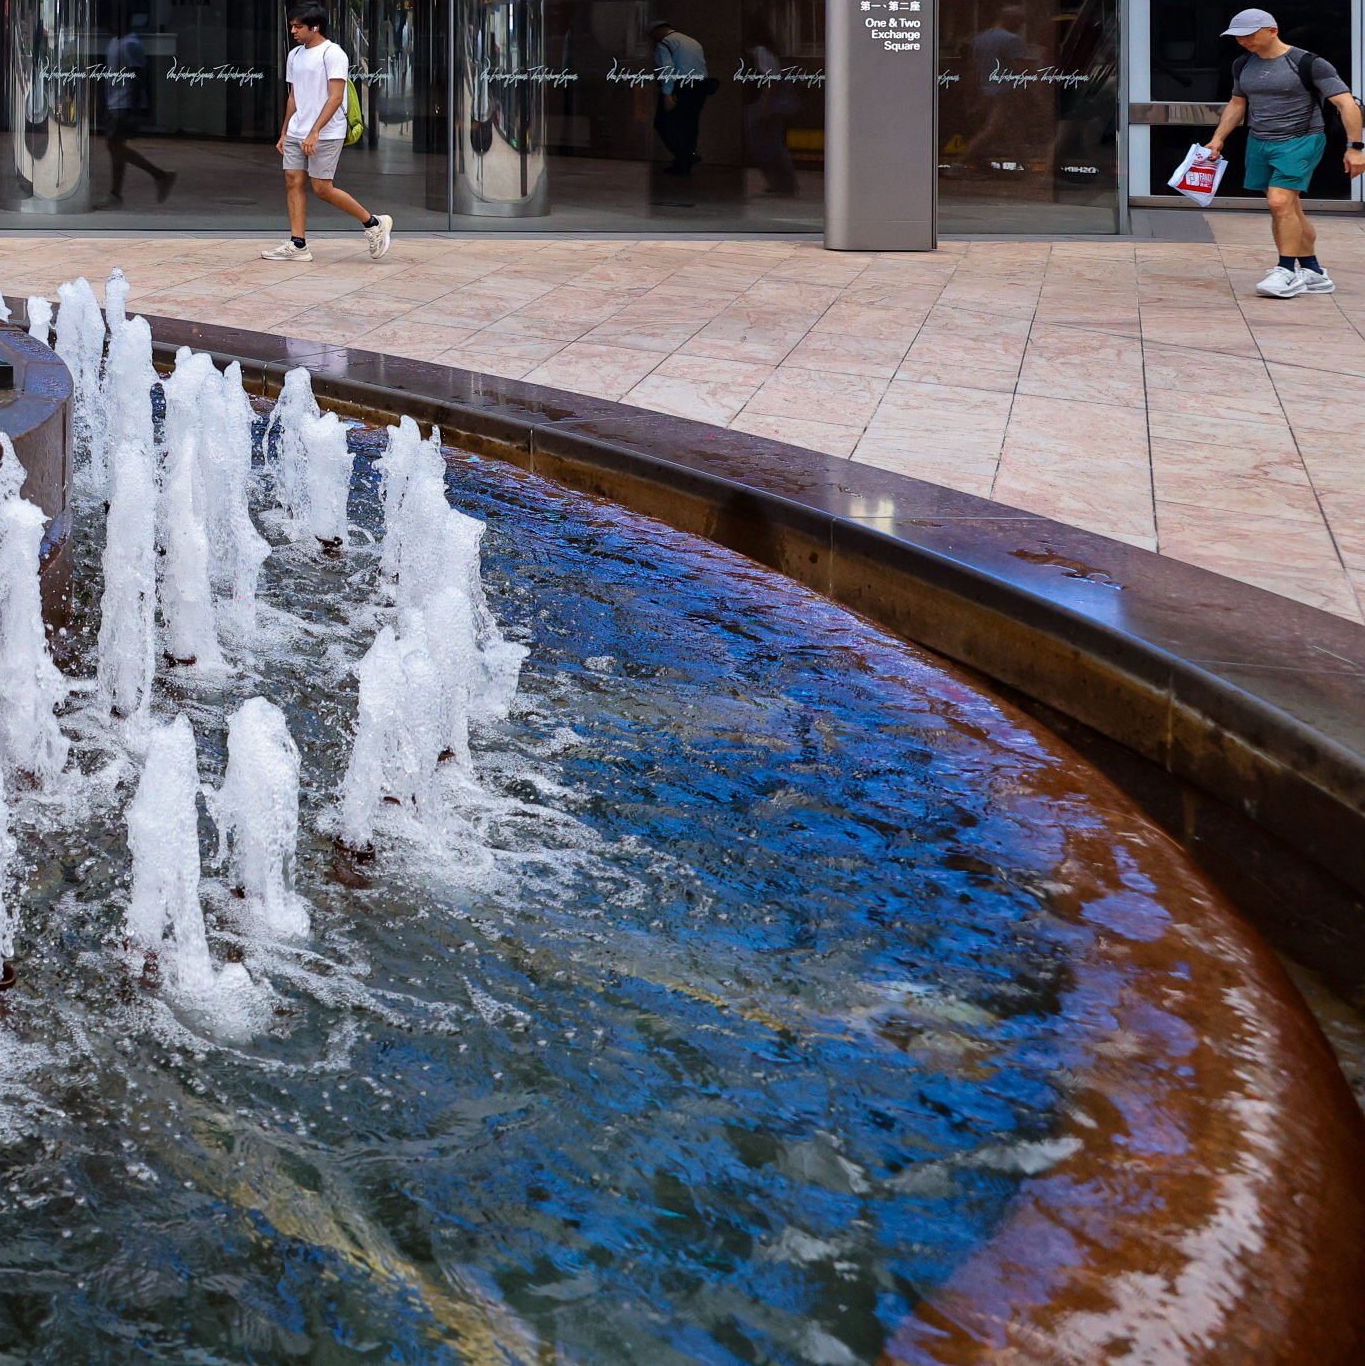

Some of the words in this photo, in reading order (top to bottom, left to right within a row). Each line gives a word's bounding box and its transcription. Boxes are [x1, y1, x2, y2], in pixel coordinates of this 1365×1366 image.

[866, 18, 886, 27] One
[889, 18, 897, 27] &
[899, 18, 920, 27] Two
[871, 30, 921, 42] Exchange
[884, 41, 921, 52] Square
